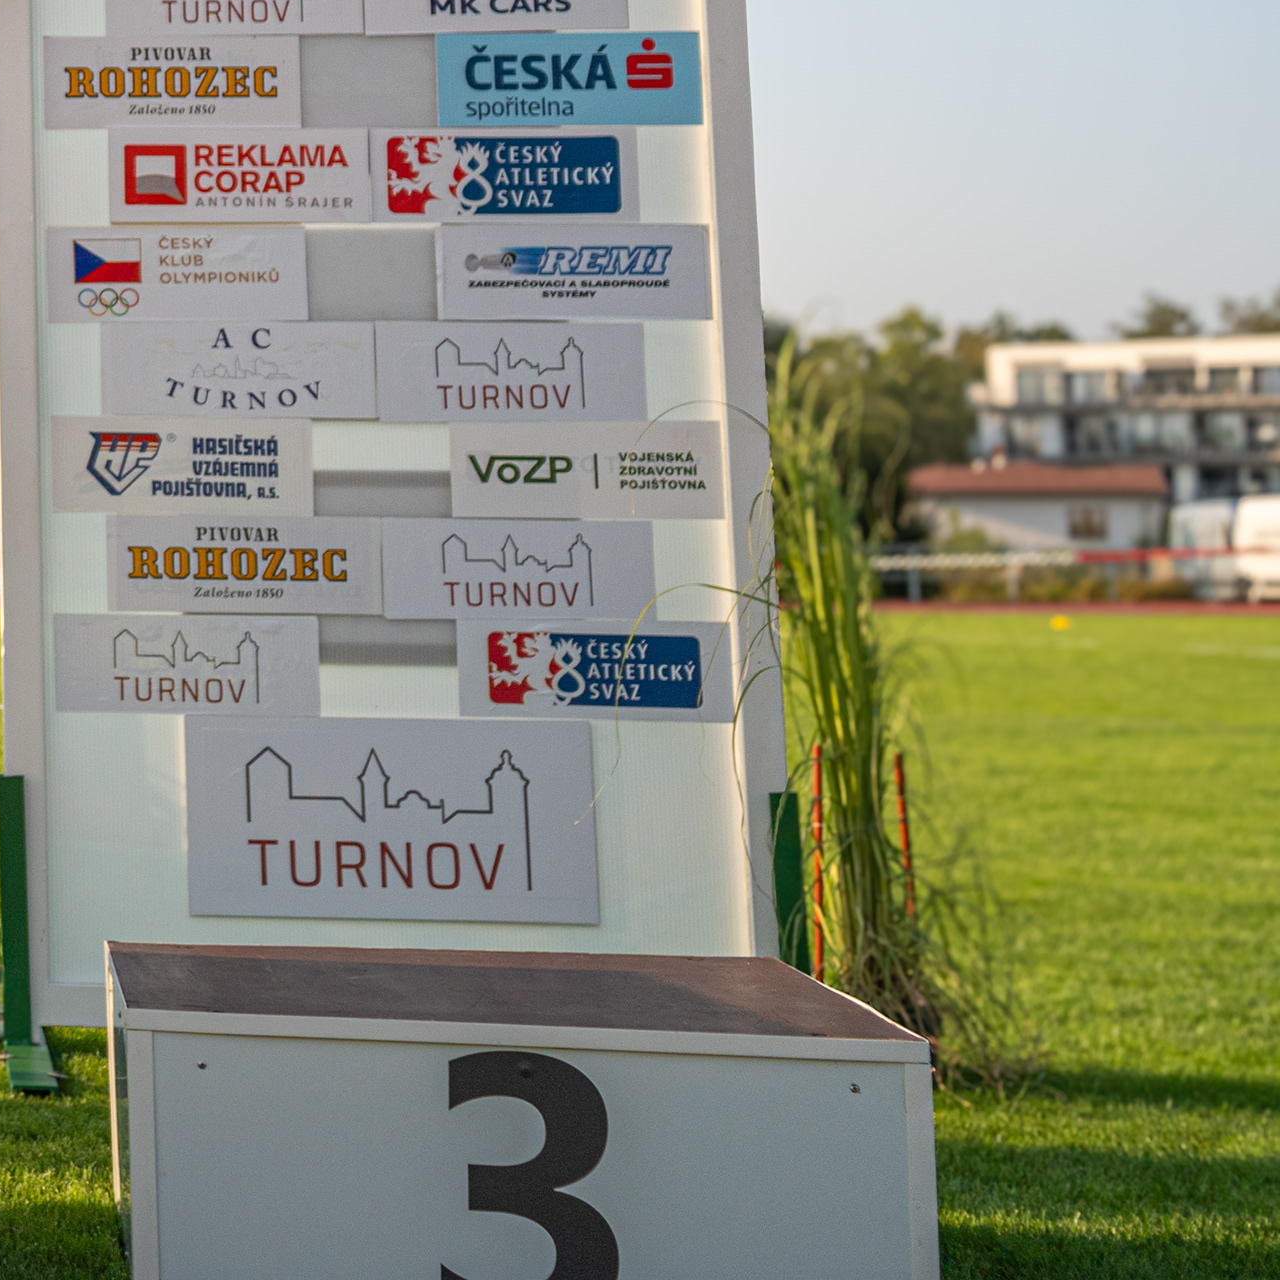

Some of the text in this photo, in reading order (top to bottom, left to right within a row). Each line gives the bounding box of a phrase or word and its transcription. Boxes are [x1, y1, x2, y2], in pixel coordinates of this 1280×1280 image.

[130, 47, 212, 62] PIVOVAR
[464, 44, 618, 90] ČESKÁ
[65, 66, 278, 98] ROHOZEC
[129, 103, 216, 117] Založeno 1850
[465, 97, 574, 121] spořitelna
[195, 144, 348, 168] REKLAMA
[495, 142, 561, 164] ČESKÝ
[194, 169, 305, 193] CORAP
[495, 162, 614, 186] ATLETICKÝ
[196, 193, 354, 208] ANTONÍN ŠRAJER
[497, 188, 554, 208] SVAZ
[158, 234, 214, 250] ČESKÝ
[159, 254, 205, 267] KLUB
[539, 245, 673, 275] REMI
[159, 267, 279, 284] OLYMPIONIKŮ
[468, 277, 670, 288] ZABEZPEČOVACÍ A SLABOPROUDÉ
[541, 288, 598, 298] SYSTÉMY
[165, 377, 322, 410] TURNOV
[437, 383, 573, 410] TURNOV
[192, 434, 278, 458] HASIČSKÁ
[618, 451, 693, 464] VOJENSKÁ
[192, 458, 279, 479] VZÁJEMNÁ
[618, 464, 697, 476] ZDRAVOTNÍ
[151, 477, 252, 499] POJIŠŤOVNA,
[619, 478, 706, 490] POJIŠŤOVNA
[195, 526, 280, 542] PIVOVAR
[128, 546, 347, 582] ROHOZEC
[193, 586, 284, 599] Založeno 1850
[443, 581, 580, 608] TURNOV
[587, 640, 648, 661] ČESKÝ
[587, 661, 696, 682] ATLETICKÝ
[113, 677, 246, 704] TURNOV
[589, 682, 641, 701] SVAZ
[248, 839, 505, 891] TURNOV
[440, 1051, 620, 1280] 3
